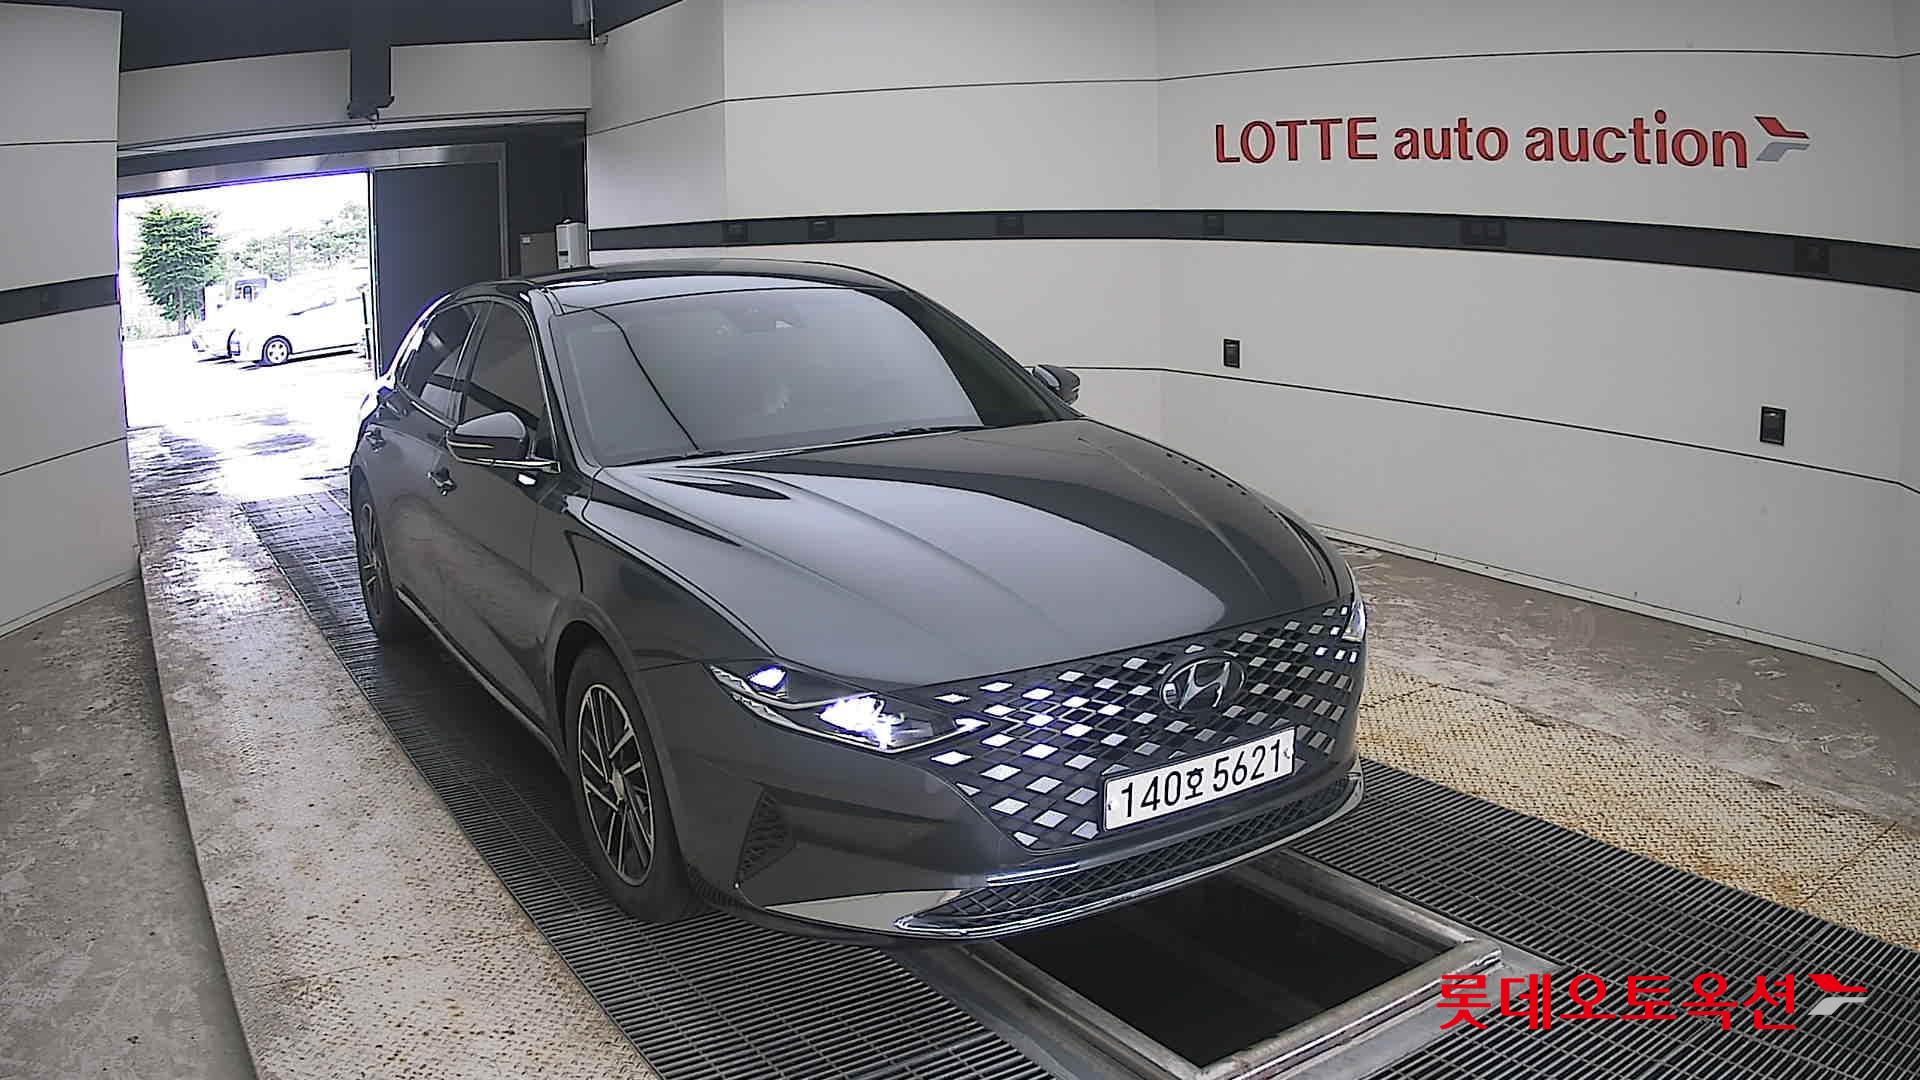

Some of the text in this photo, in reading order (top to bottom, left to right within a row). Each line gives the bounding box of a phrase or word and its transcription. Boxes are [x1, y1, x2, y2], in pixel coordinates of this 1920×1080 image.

[1215, 109, 1748, 169] LOTTE auto auction
[1212, 738, 1281, 793] 5621
